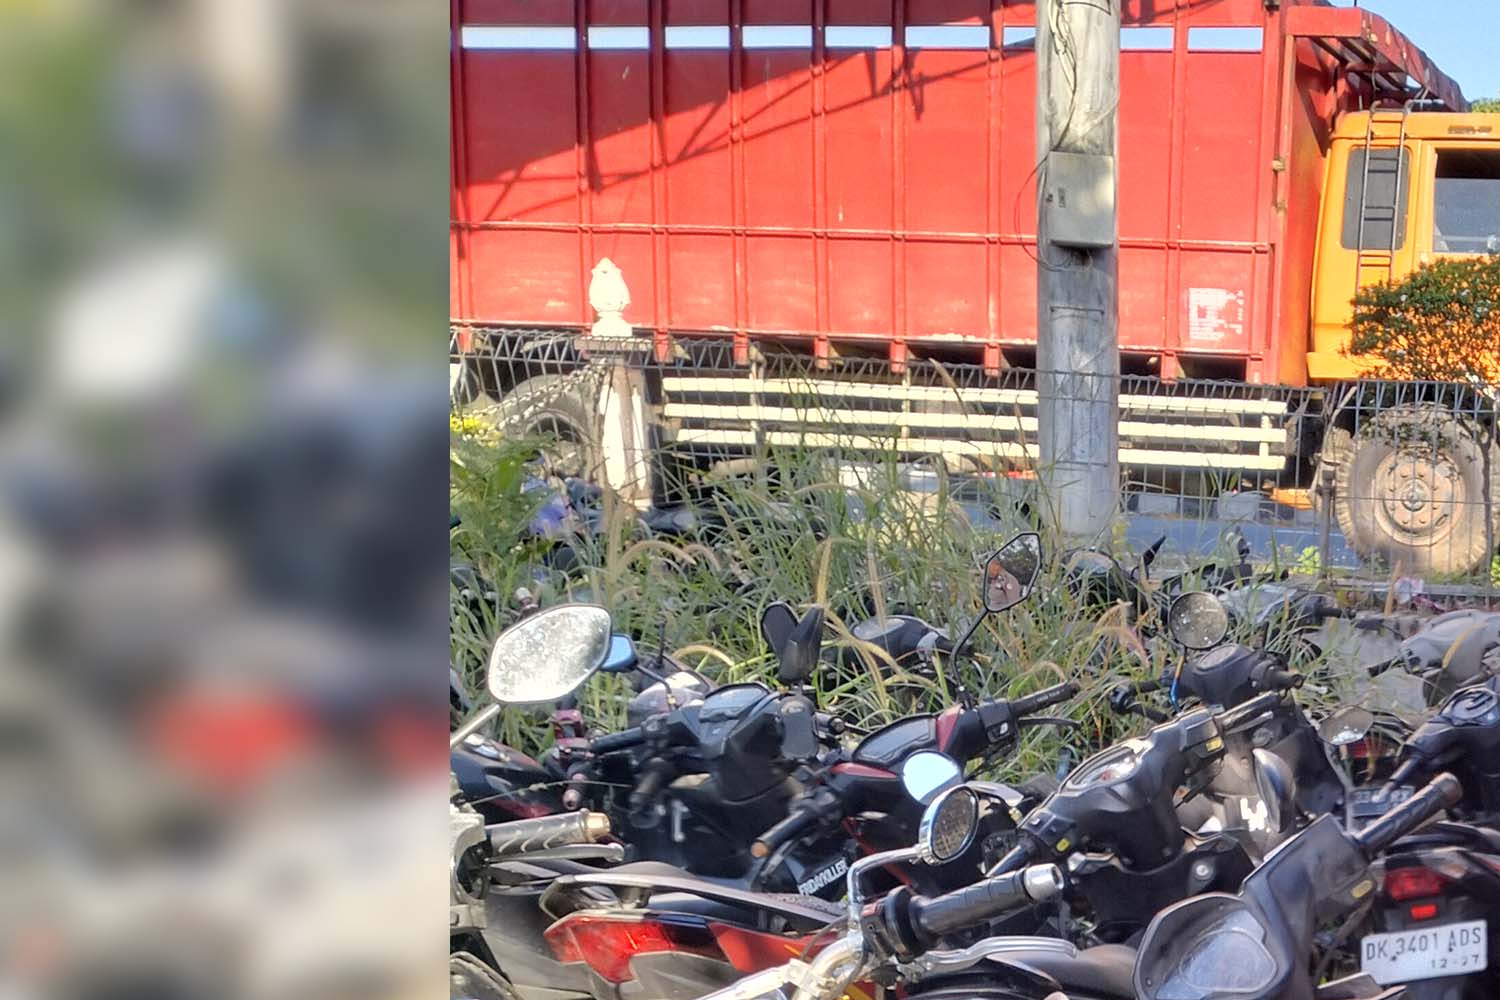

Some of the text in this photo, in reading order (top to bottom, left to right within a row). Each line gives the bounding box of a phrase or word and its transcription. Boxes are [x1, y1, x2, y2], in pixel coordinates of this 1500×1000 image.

[1366, 927, 1481, 960] DK 3401 ADS
